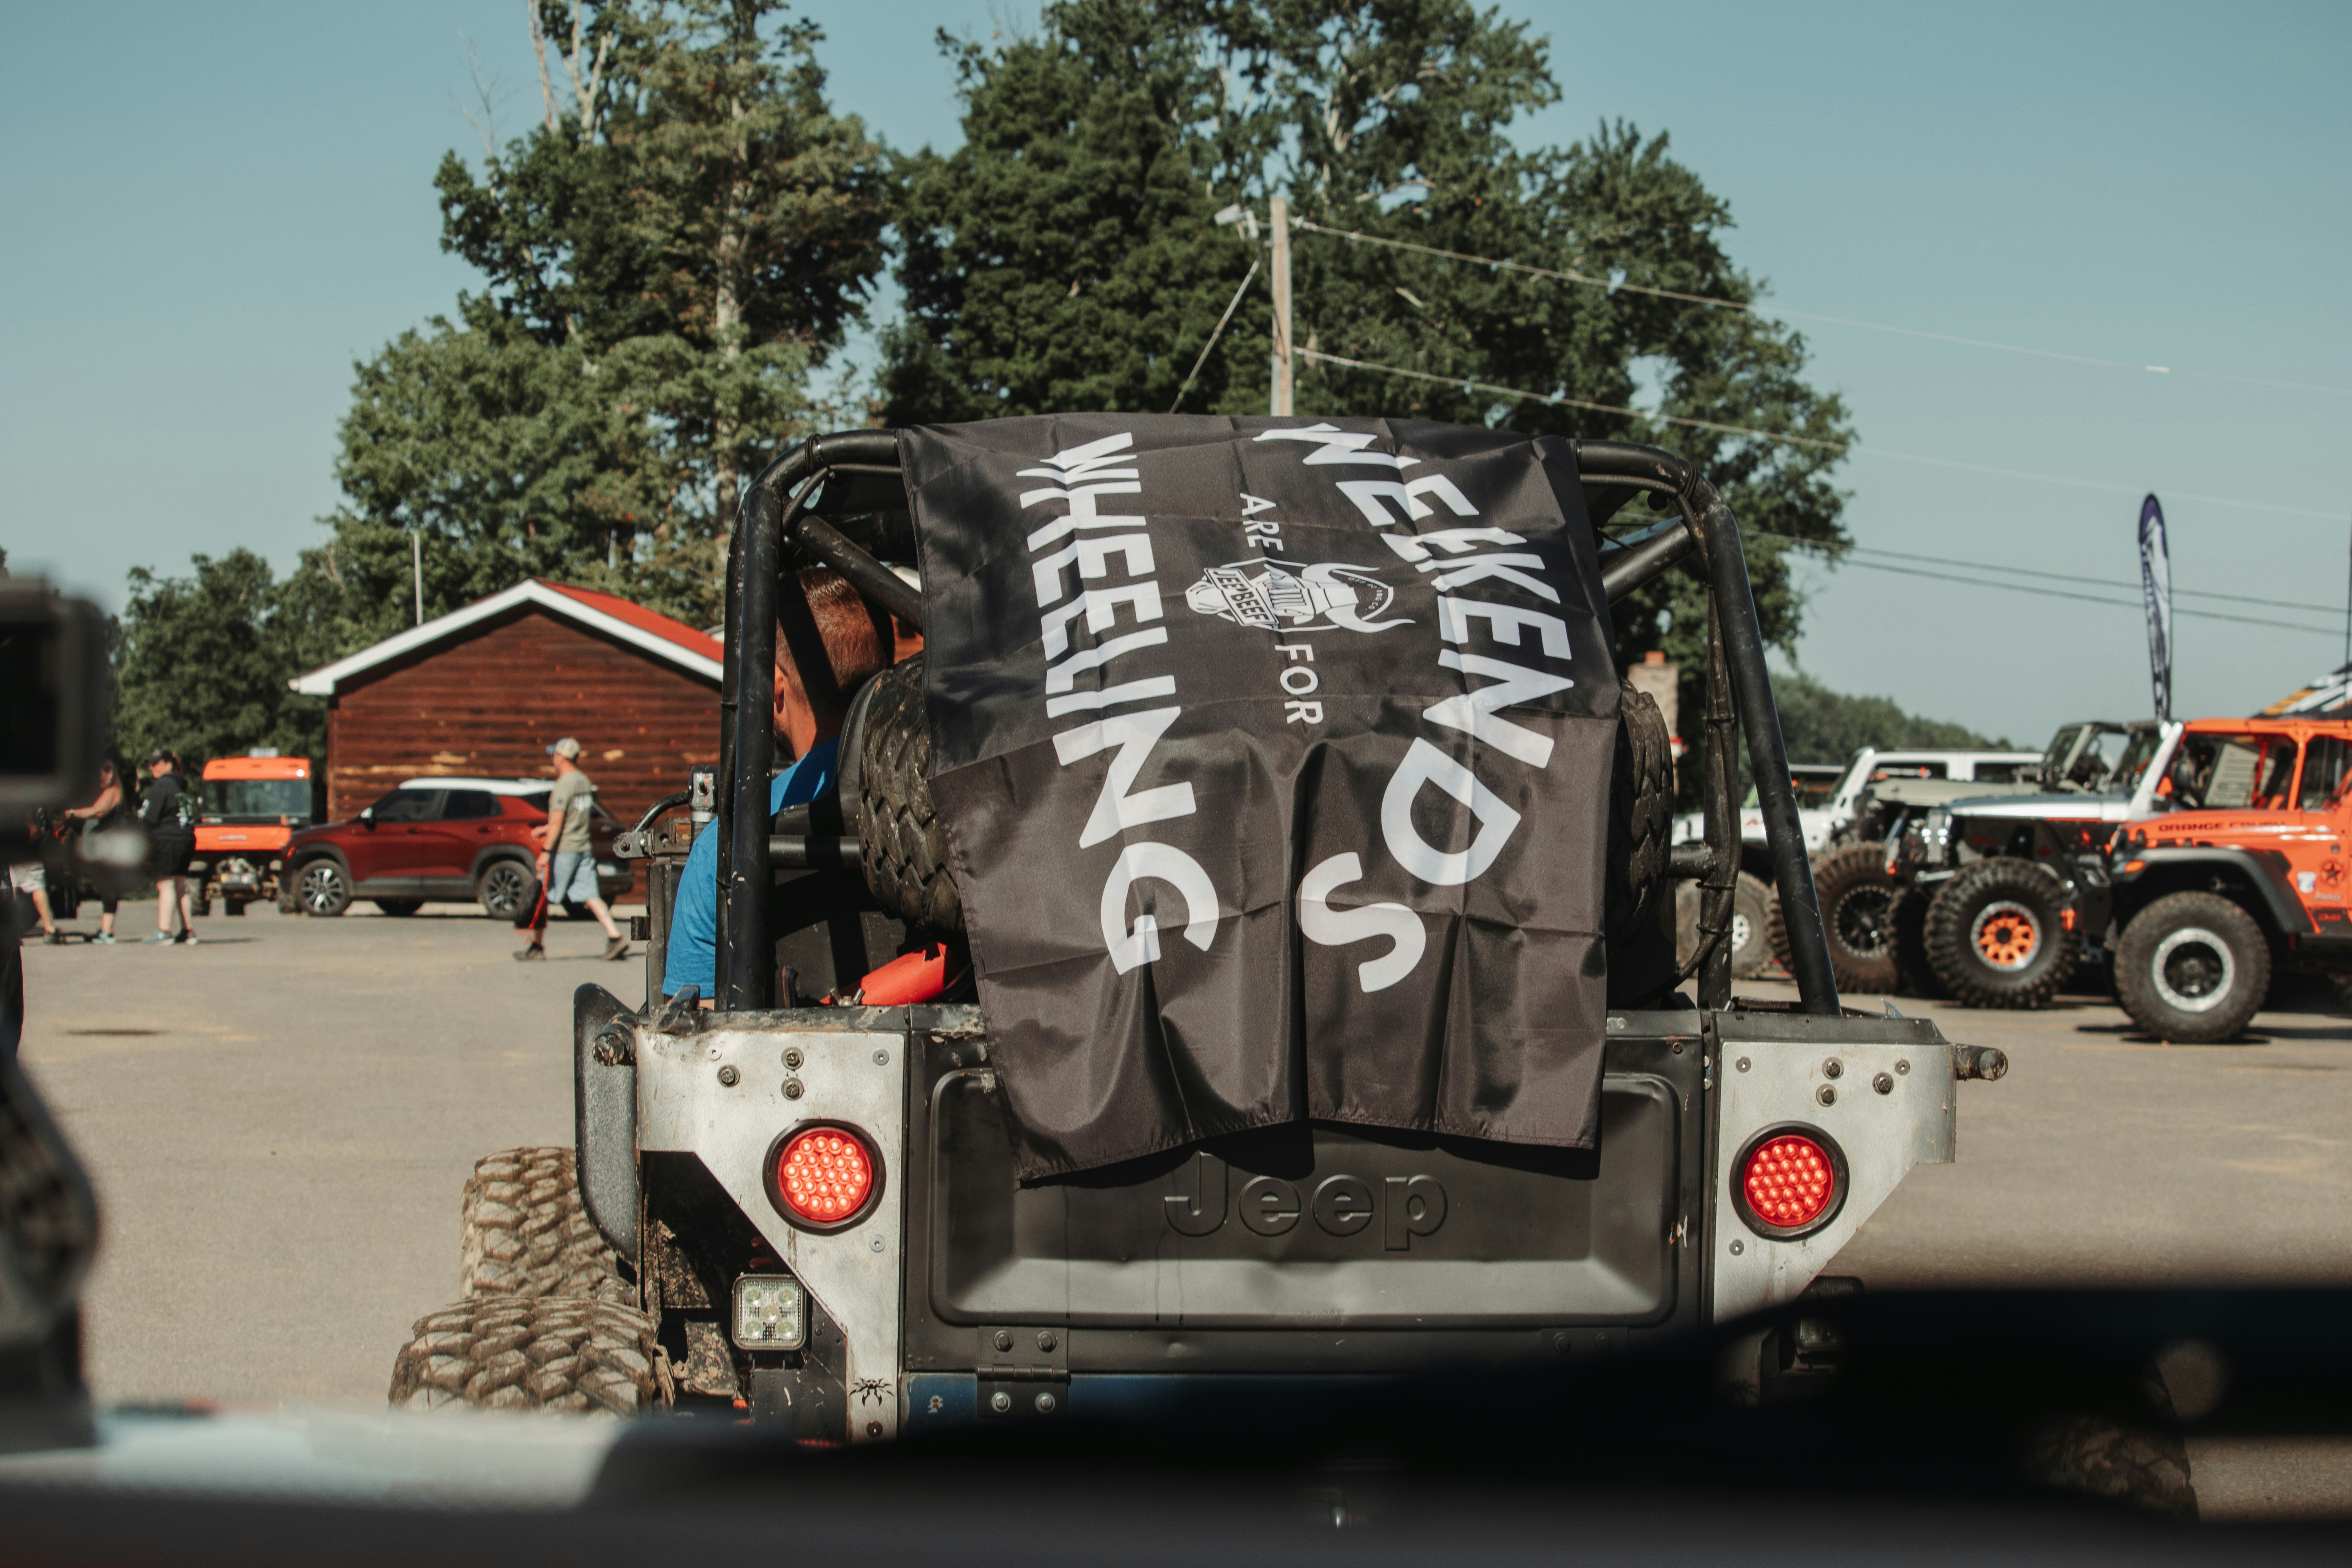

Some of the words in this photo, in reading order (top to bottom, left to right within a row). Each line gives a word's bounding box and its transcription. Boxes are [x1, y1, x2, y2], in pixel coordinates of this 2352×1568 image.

[1017, 432, 1220, 975] WHEELING
[1230, 592, 1270, 619] BEEF
[1240, 493, 1284, 551] ARE
[1275, 644, 1323, 724] FOR
[1253, 423, 1573, 993] WEEKENDS
[1164, 1152, 1448, 1251] Jeep
